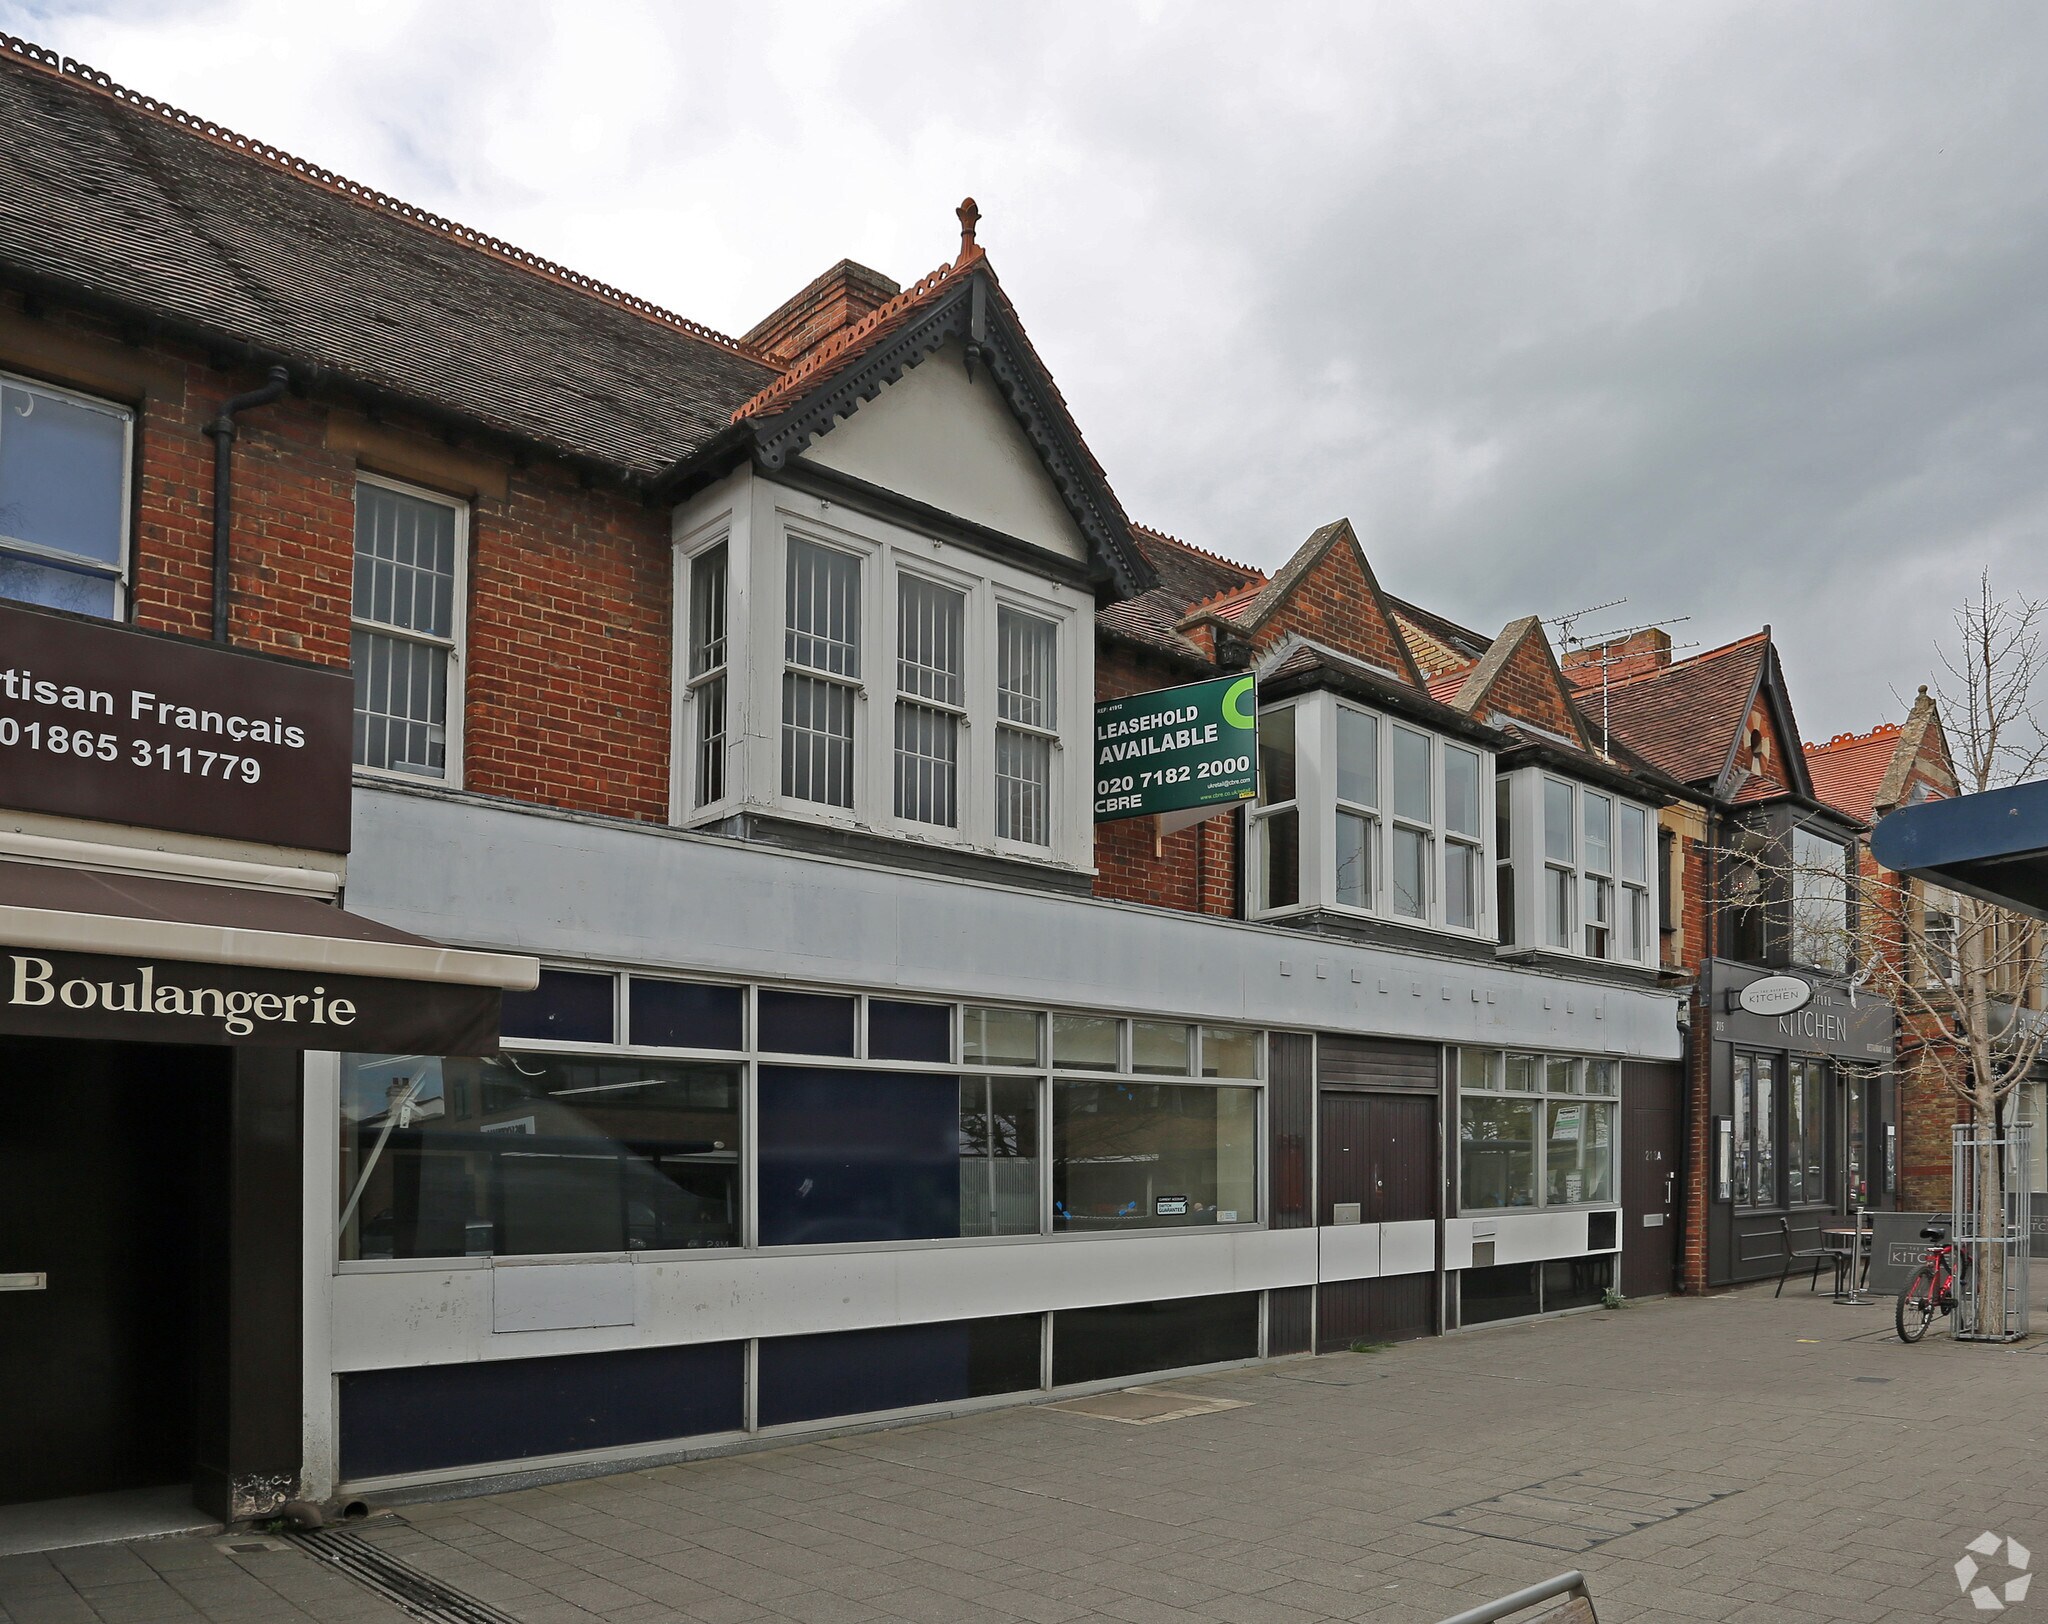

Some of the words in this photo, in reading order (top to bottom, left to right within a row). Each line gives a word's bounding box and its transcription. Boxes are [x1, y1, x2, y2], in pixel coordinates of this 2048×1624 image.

[0, 668, 114, 715] tisan
[131, 690, 305, 748] Français
[1097, 705, 1198, 741] LEASEHOLD
[0, 717, 118, 762] 01865
[131, 739, 261, 784] 311779
[1099, 723, 1219, 765] AVAILABLE
[1097, 775, 1134, 795] 020
[1140, 765, 1191, 788] 7182
[1197, 755, 1250, 779] 2000
[1094, 794, 1142, 813] CBRE
[8, 955, 357, 1036] Boulangerie
[1749, 991, 1799, 1003] KITCHEN
[1778, 1009, 1847, 1042] KITCHEN
